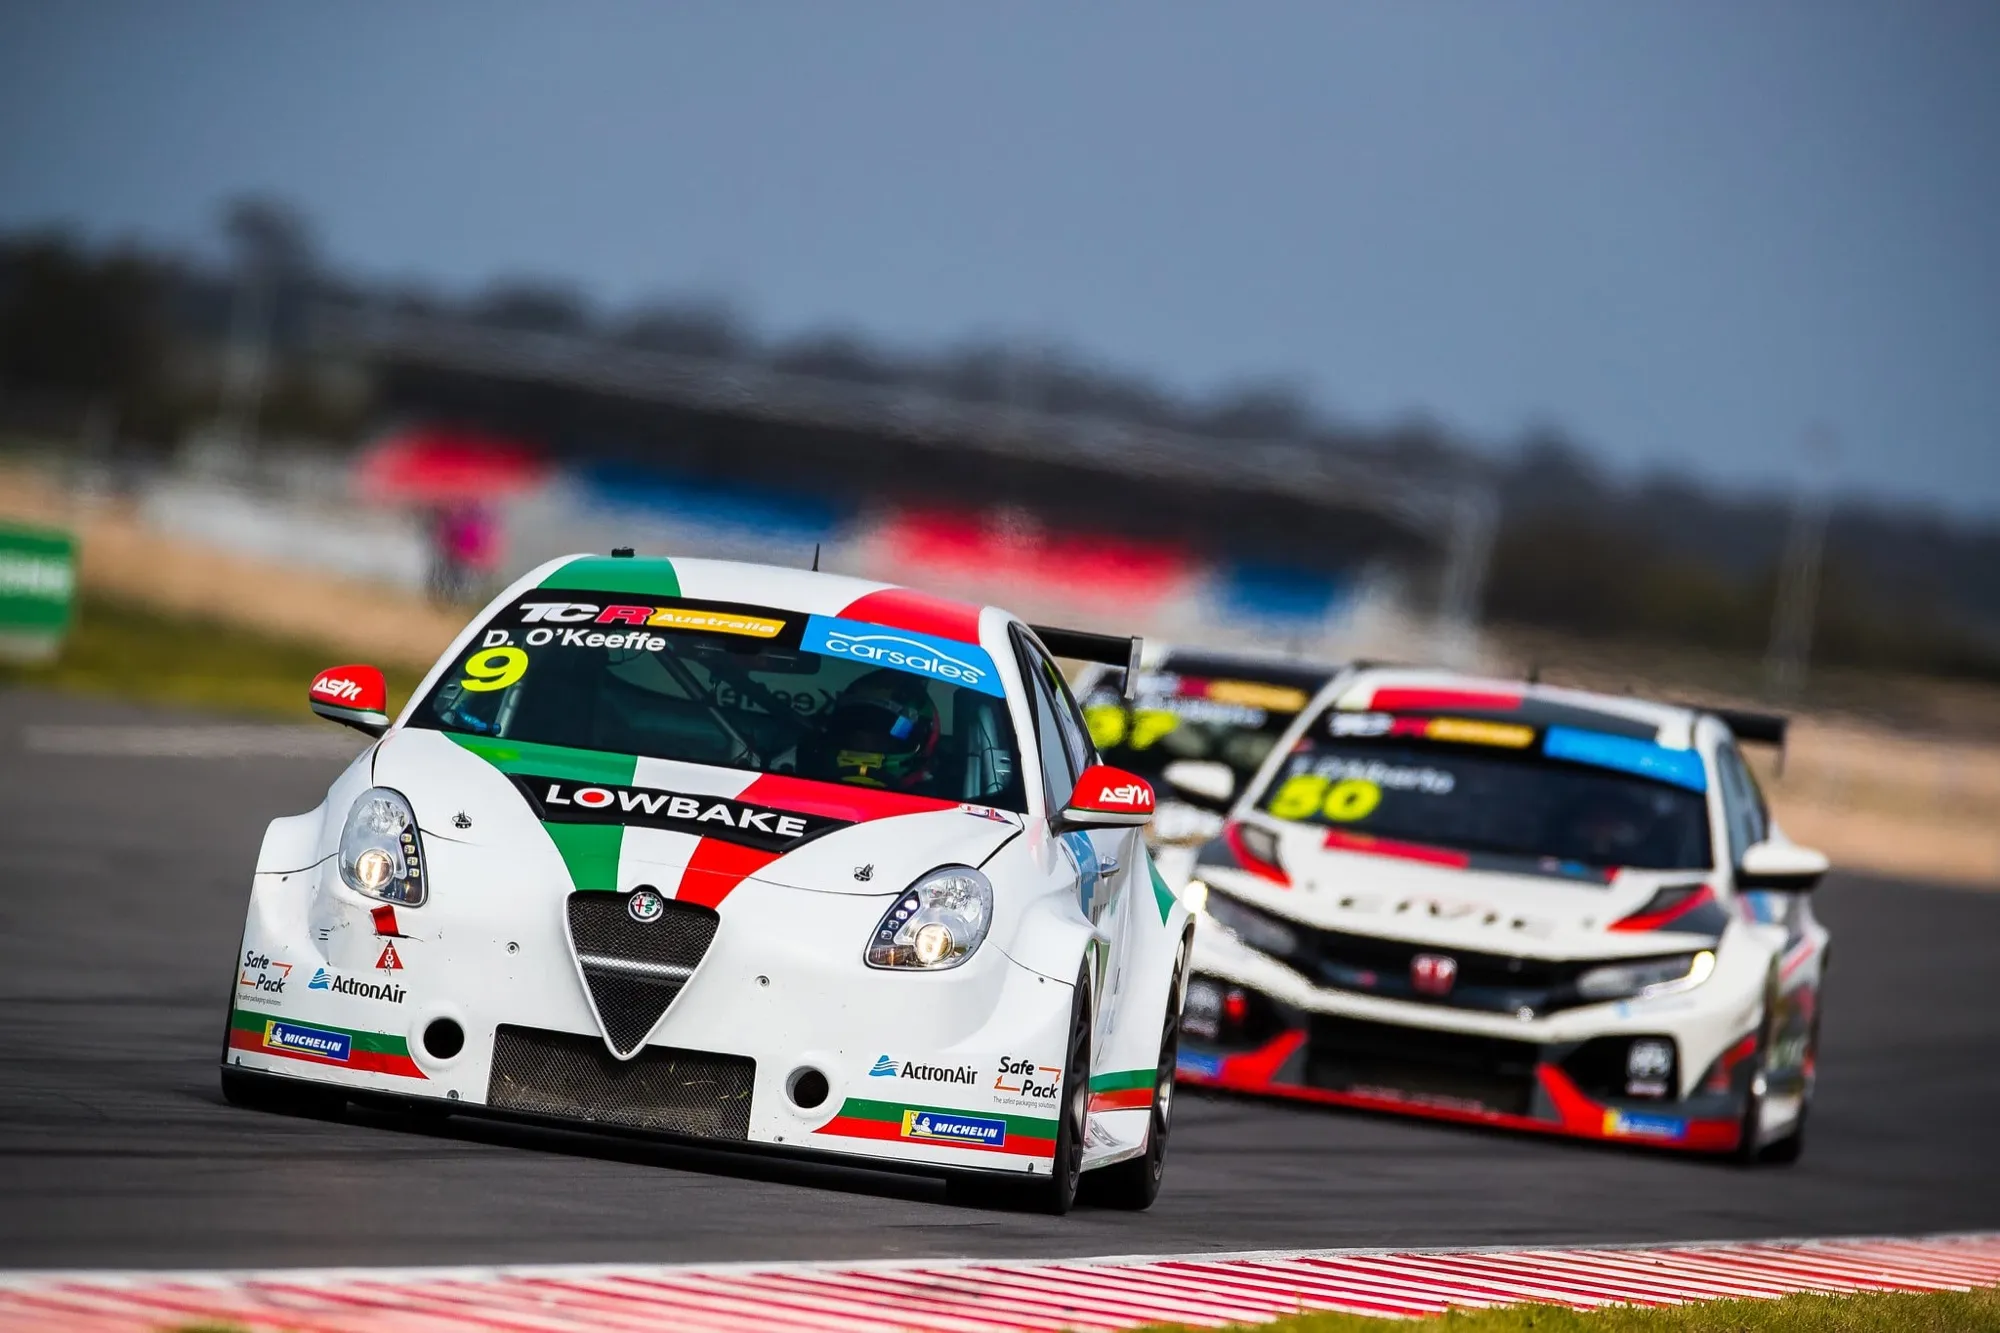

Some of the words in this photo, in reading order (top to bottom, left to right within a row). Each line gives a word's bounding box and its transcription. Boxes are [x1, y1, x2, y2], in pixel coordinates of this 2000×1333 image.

[519, 603, 654, 625] TCR
[656, 612, 776, 633] Australia
[482, 629, 515, 648] D.
[526, 628, 666, 652] O'Keeffe
[460, 647, 529, 692] 9
[825, 638, 979, 685] carsales
[312, 676, 363, 701] ASM
[1098, 784, 1151, 806] ASM
[1269, 774, 1382, 822] 50
[545, 784, 808, 837] LOWBAKE
[244, 950, 270, 970] Safe
[255, 973, 286, 993] Pack
[331, 975, 407, 1004] ActronAir
[284, 1033, 342, 1052] MICHELIN
[900, 1061, 978, 1085] ActronAir
[997, 1056, 1035, 1075] Safe
[1021, 1079, 1059, 1099] Pack
[933, 1122, 998, 1138] MICHELIN
